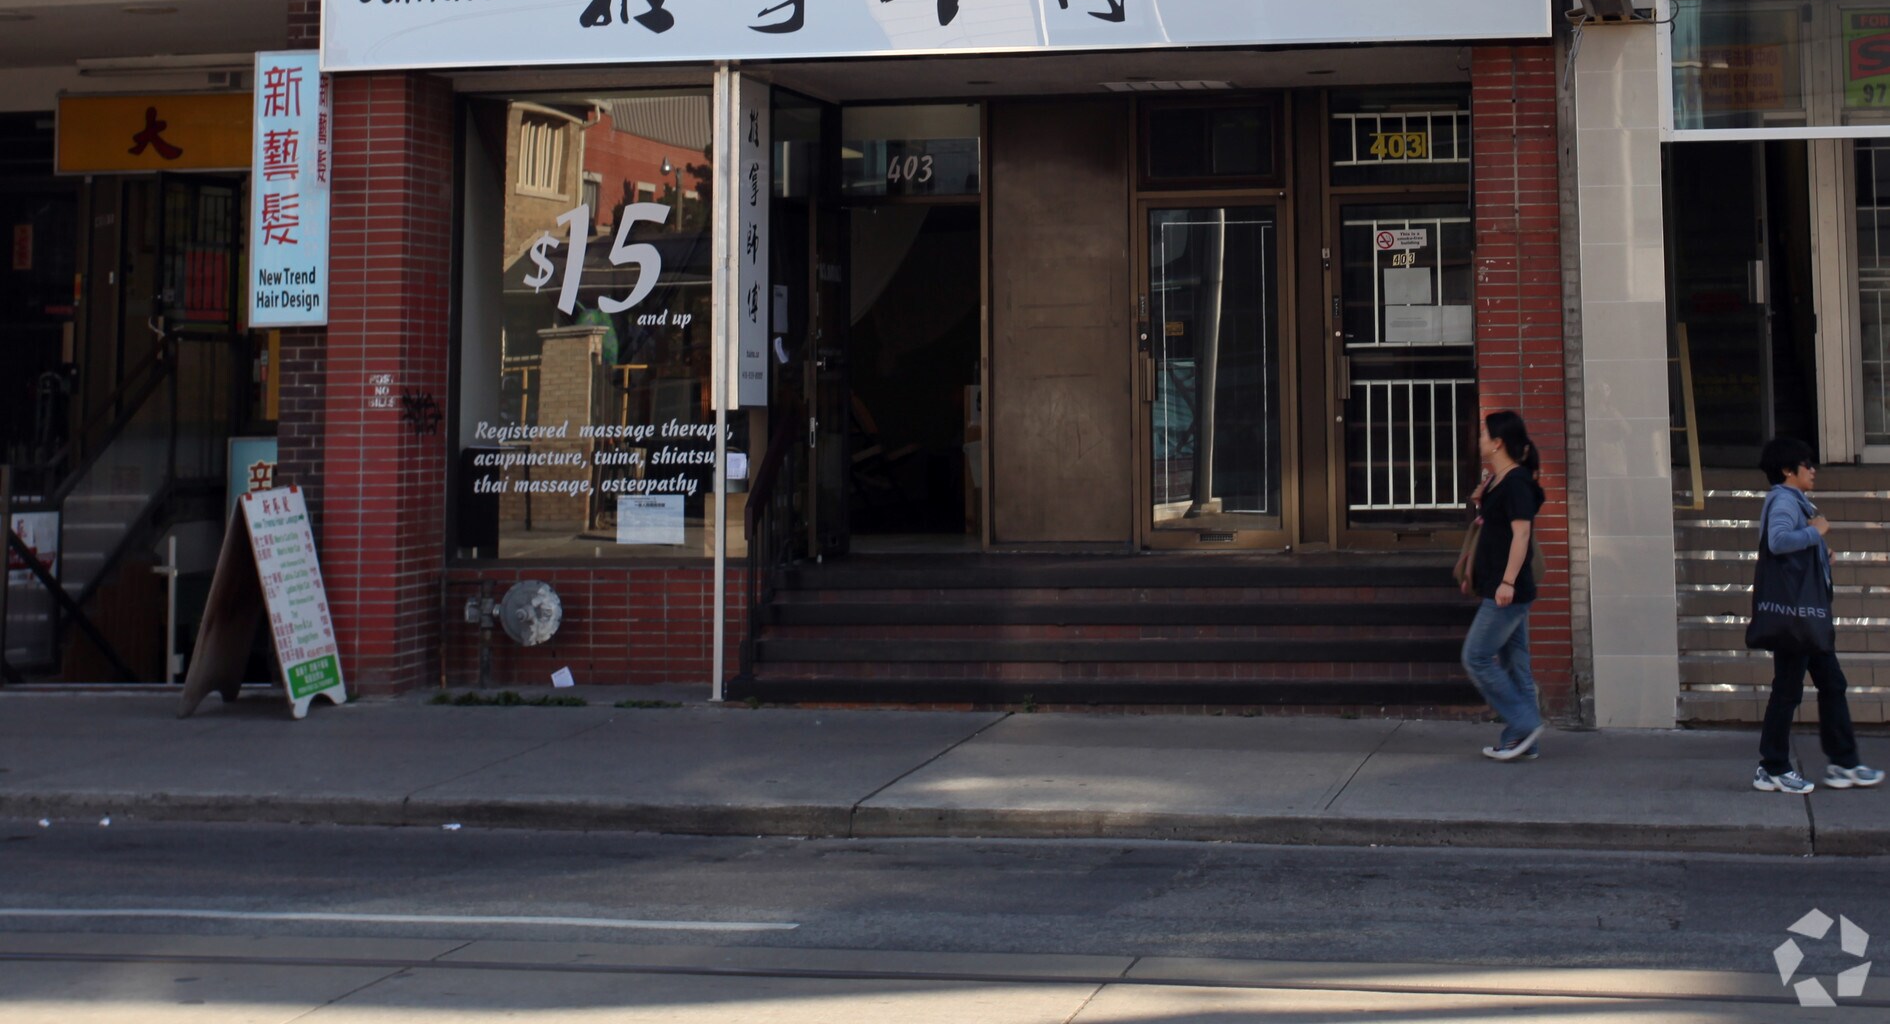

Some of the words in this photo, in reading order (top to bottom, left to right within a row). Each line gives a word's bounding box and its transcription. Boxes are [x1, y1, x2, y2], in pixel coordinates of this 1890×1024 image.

[128, 107, 183, 160] 大
[261, 66, 304, 245] 新藝髮
[1369, 134, 1423, 159] 403
[888, 154, 934, 183] 403
[523, 202, 671, 316] $15
[1393, 253, 1415, 265] 403
[259, 268, 282, 286] New
[284, 267, 316, 285] Trend
[257, 291, 279, 309] Hair
[281, 290, 319, 312] Design
[637, 309, 666, 326] and
[672, 312, 691, 329] up
[475, 421, 569, 443] Registered
[579, 424, 655, 443] massage
[474, 450, 587, 469] acupuncture,
[594, 447, 645, 468] tuina,
[474, 475, 508, 494] thai
[513, 478, 595, 497] massage,
[601, 473, 698, 497] osteopathy
[1757, 602, 1826, 619] WINNERS
